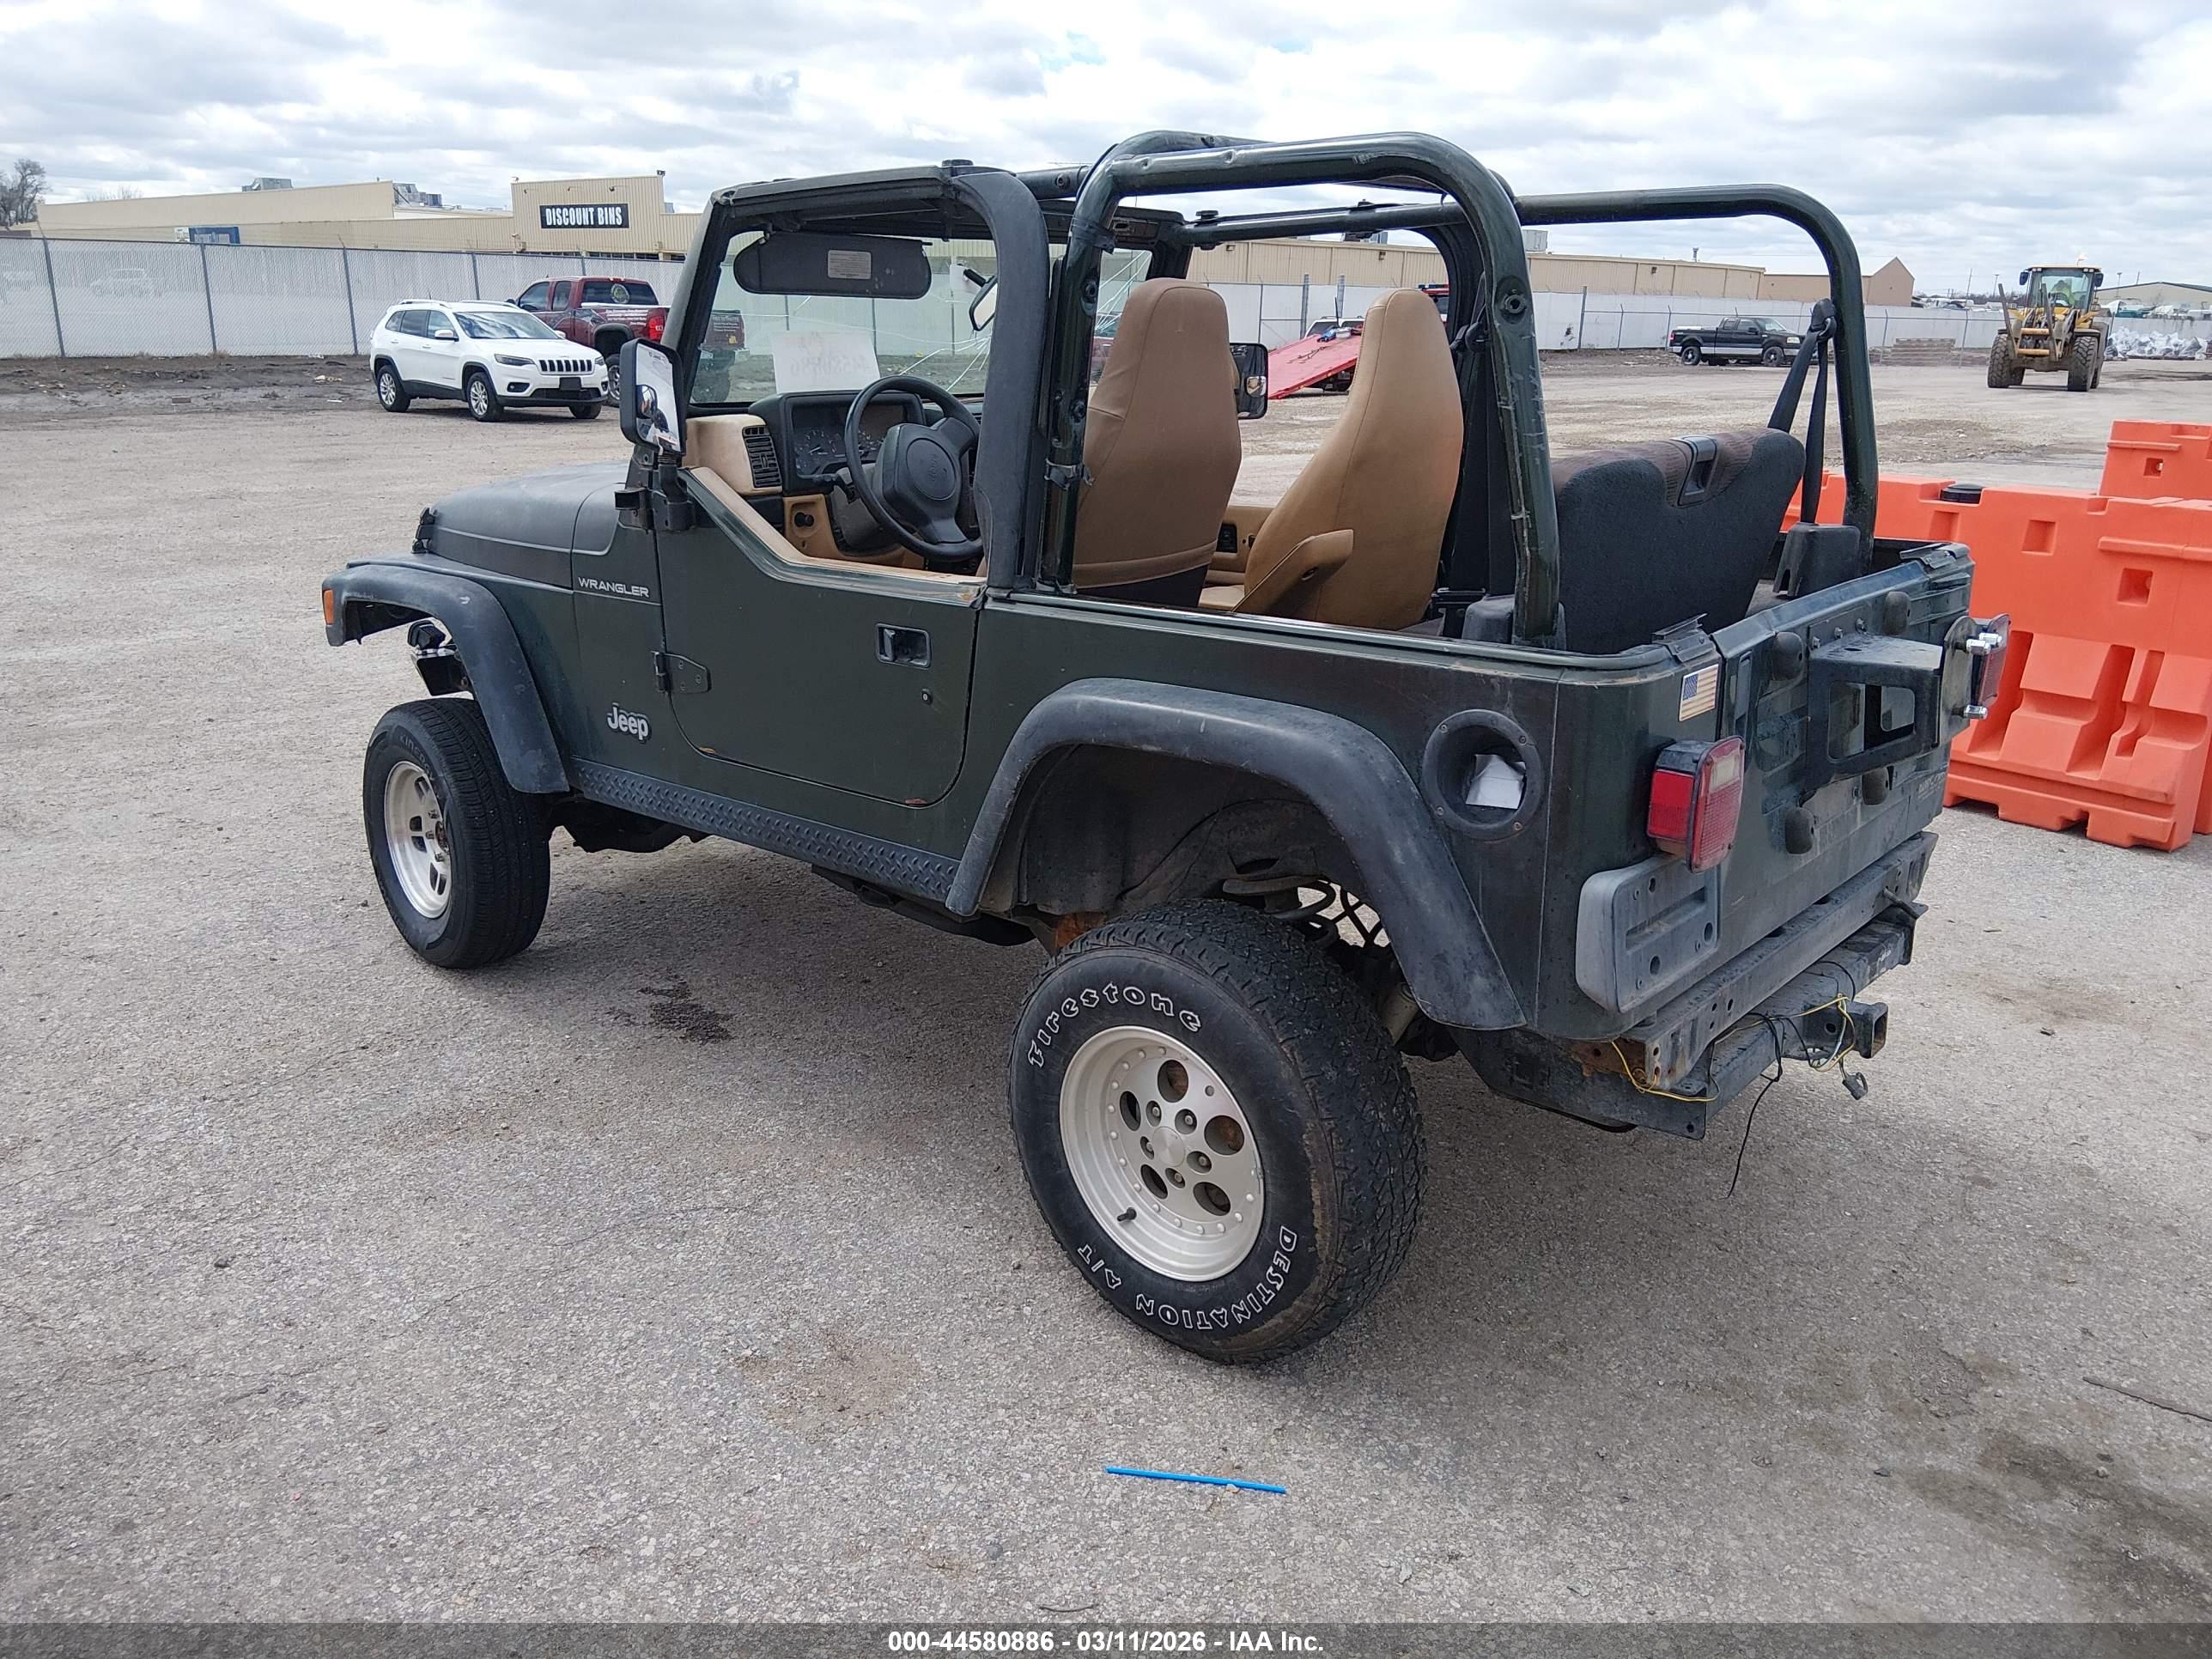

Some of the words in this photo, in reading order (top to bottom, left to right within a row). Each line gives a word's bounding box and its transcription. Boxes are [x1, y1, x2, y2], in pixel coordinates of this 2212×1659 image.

[545, 207, 594, 226] DISCOUNT
[597, 206, 623, 226] BINS
[578, 577, 649, 598] WRANGLER
[607, 702, 649, 741] Jeep
[1028, 982, 1201, 1067] Firestone
[1077, 1244, 1122, 1289] A/T
[1136, 1226, 1297, 1329] DESTINATION
